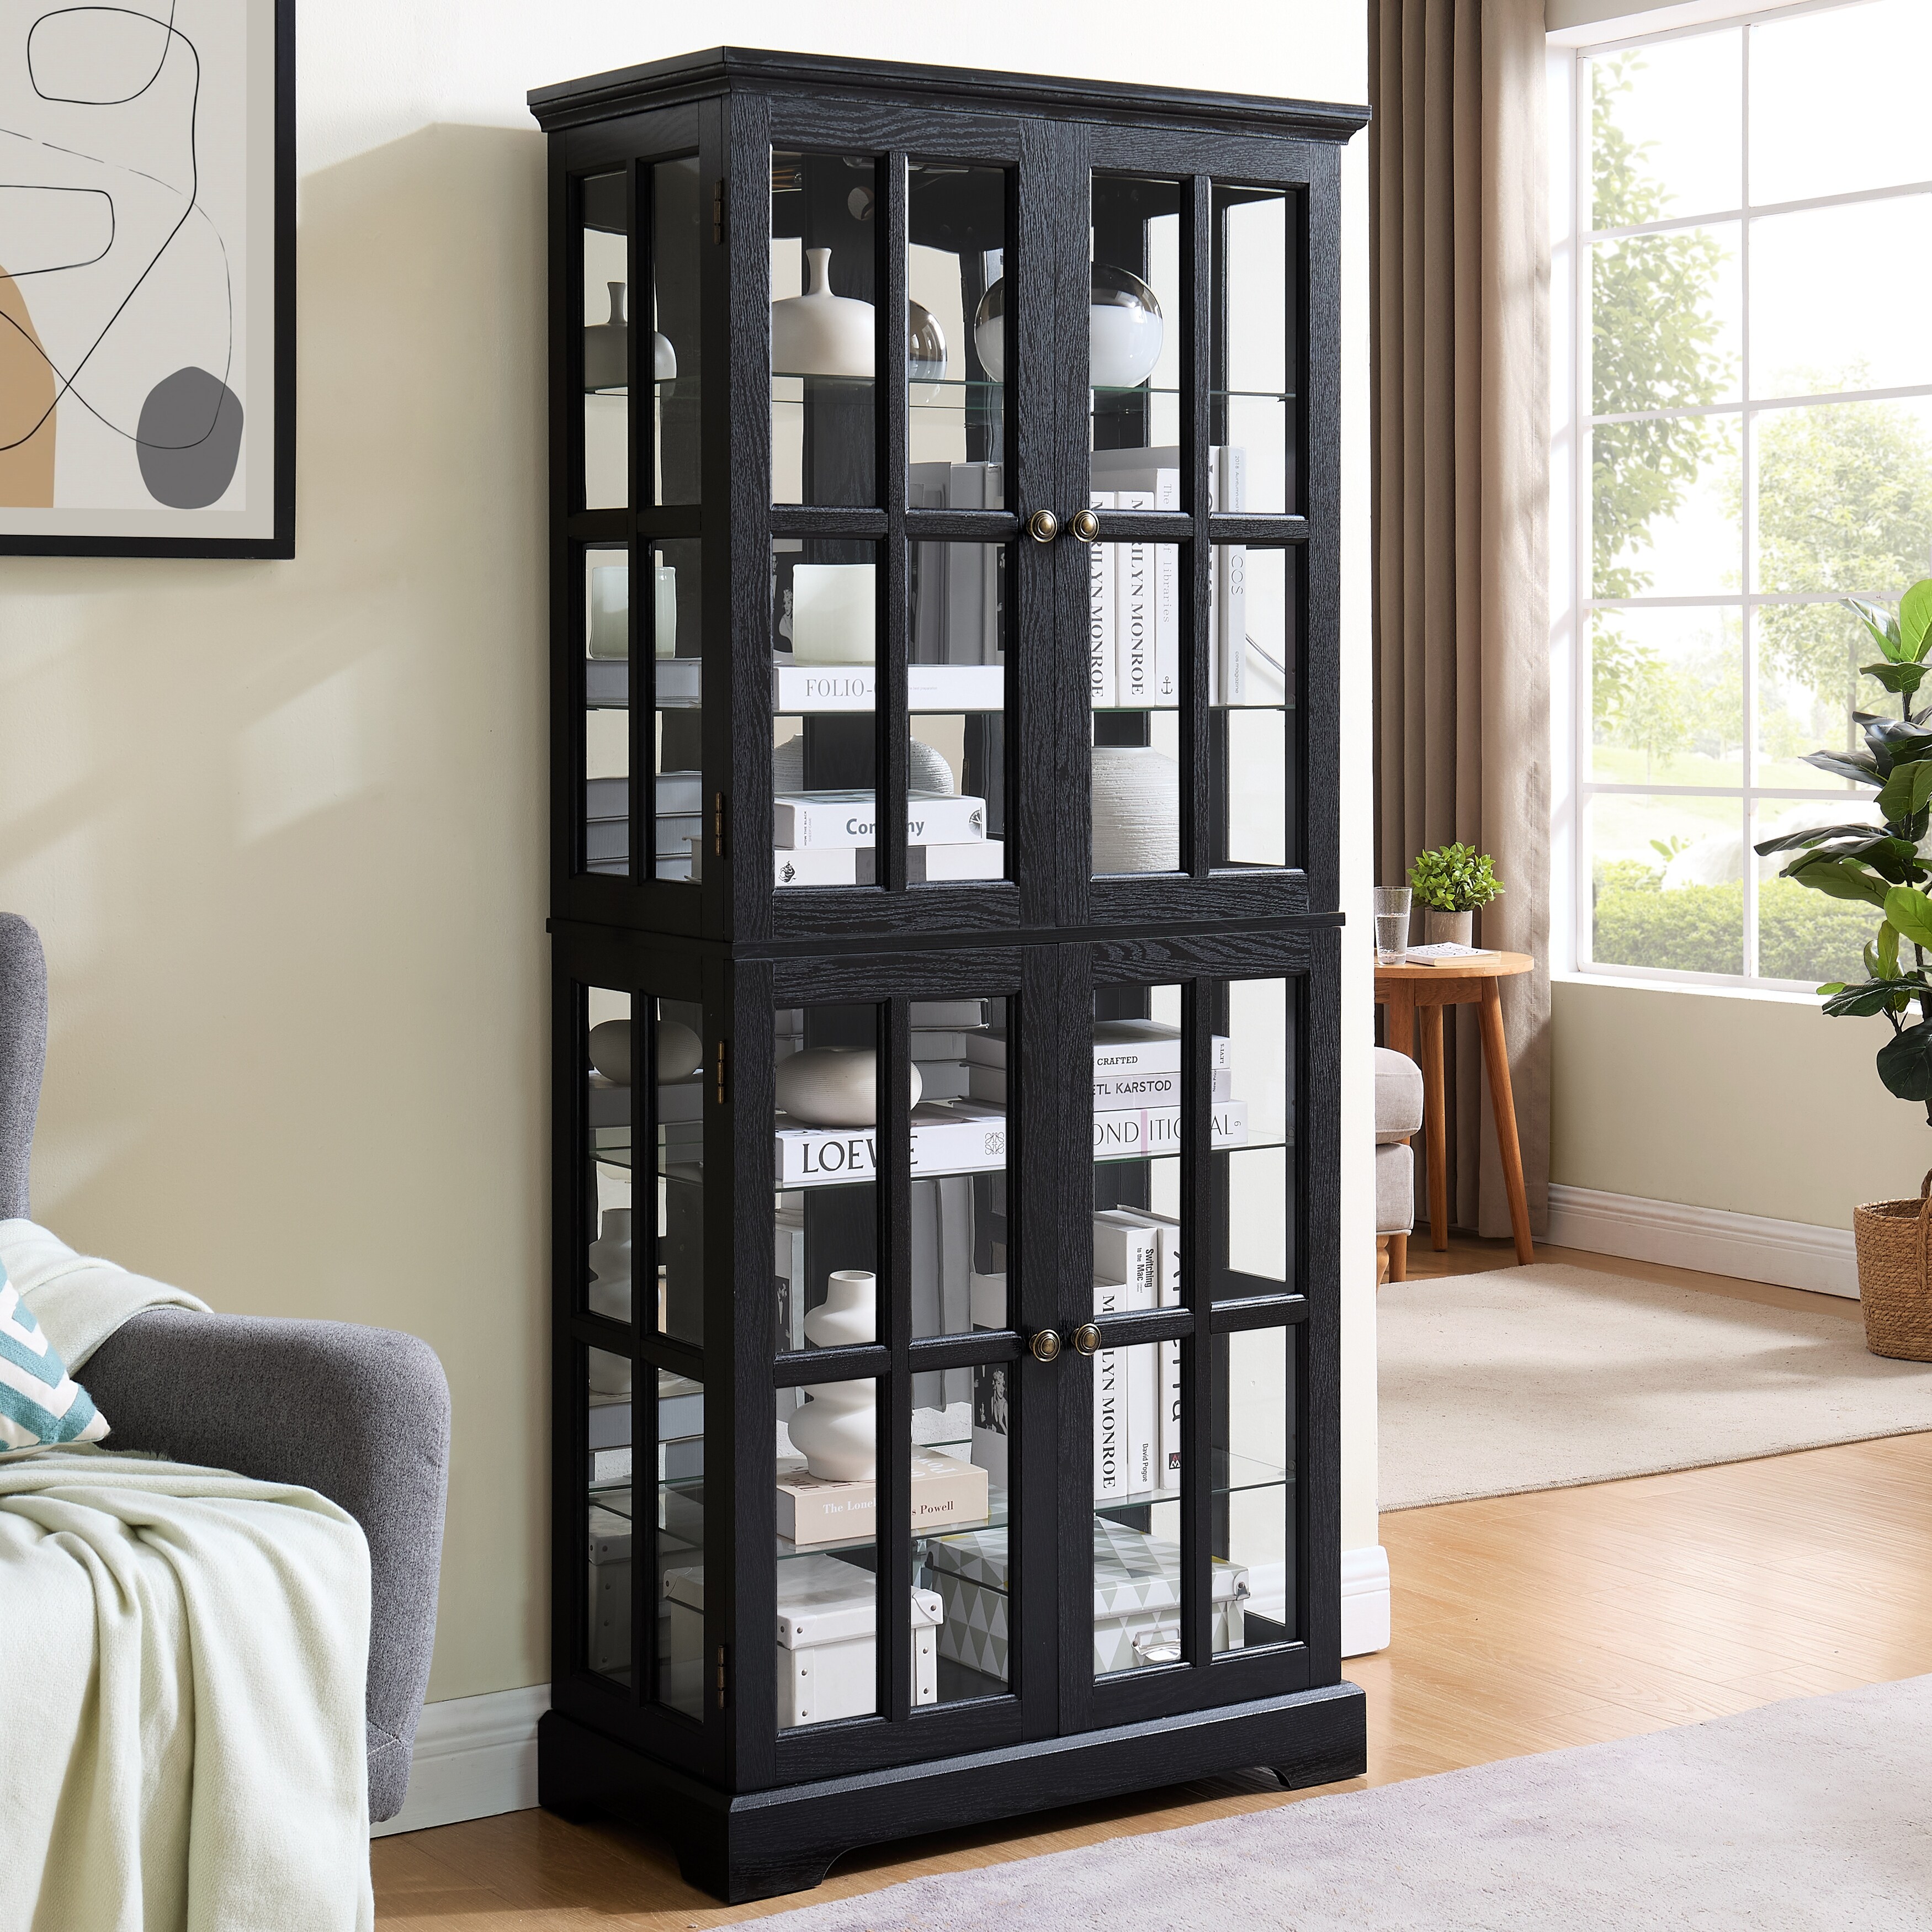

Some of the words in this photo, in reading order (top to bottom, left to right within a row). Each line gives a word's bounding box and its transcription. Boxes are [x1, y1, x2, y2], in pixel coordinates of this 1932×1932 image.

[1164, 561, 1172, 623] libraries
[1231, 554, 1244, 596] COS
[1091, 605, 1103, 697] MONROE
[1131, 603, 1144, 695] MONROE
[805, 678, 875, 697] FOLIO-
[1097, 1056, 1138, 1066] CRAFTED
[1116, 1080, 1172, 1094] KARSTOD
[1145, 1249, 1154, 1287] Switching
[1102, 1397, 1116, 1489] MONROE
[823, 1503, 843, 1514] The
[920, 1500, 953, 1515] Powell
